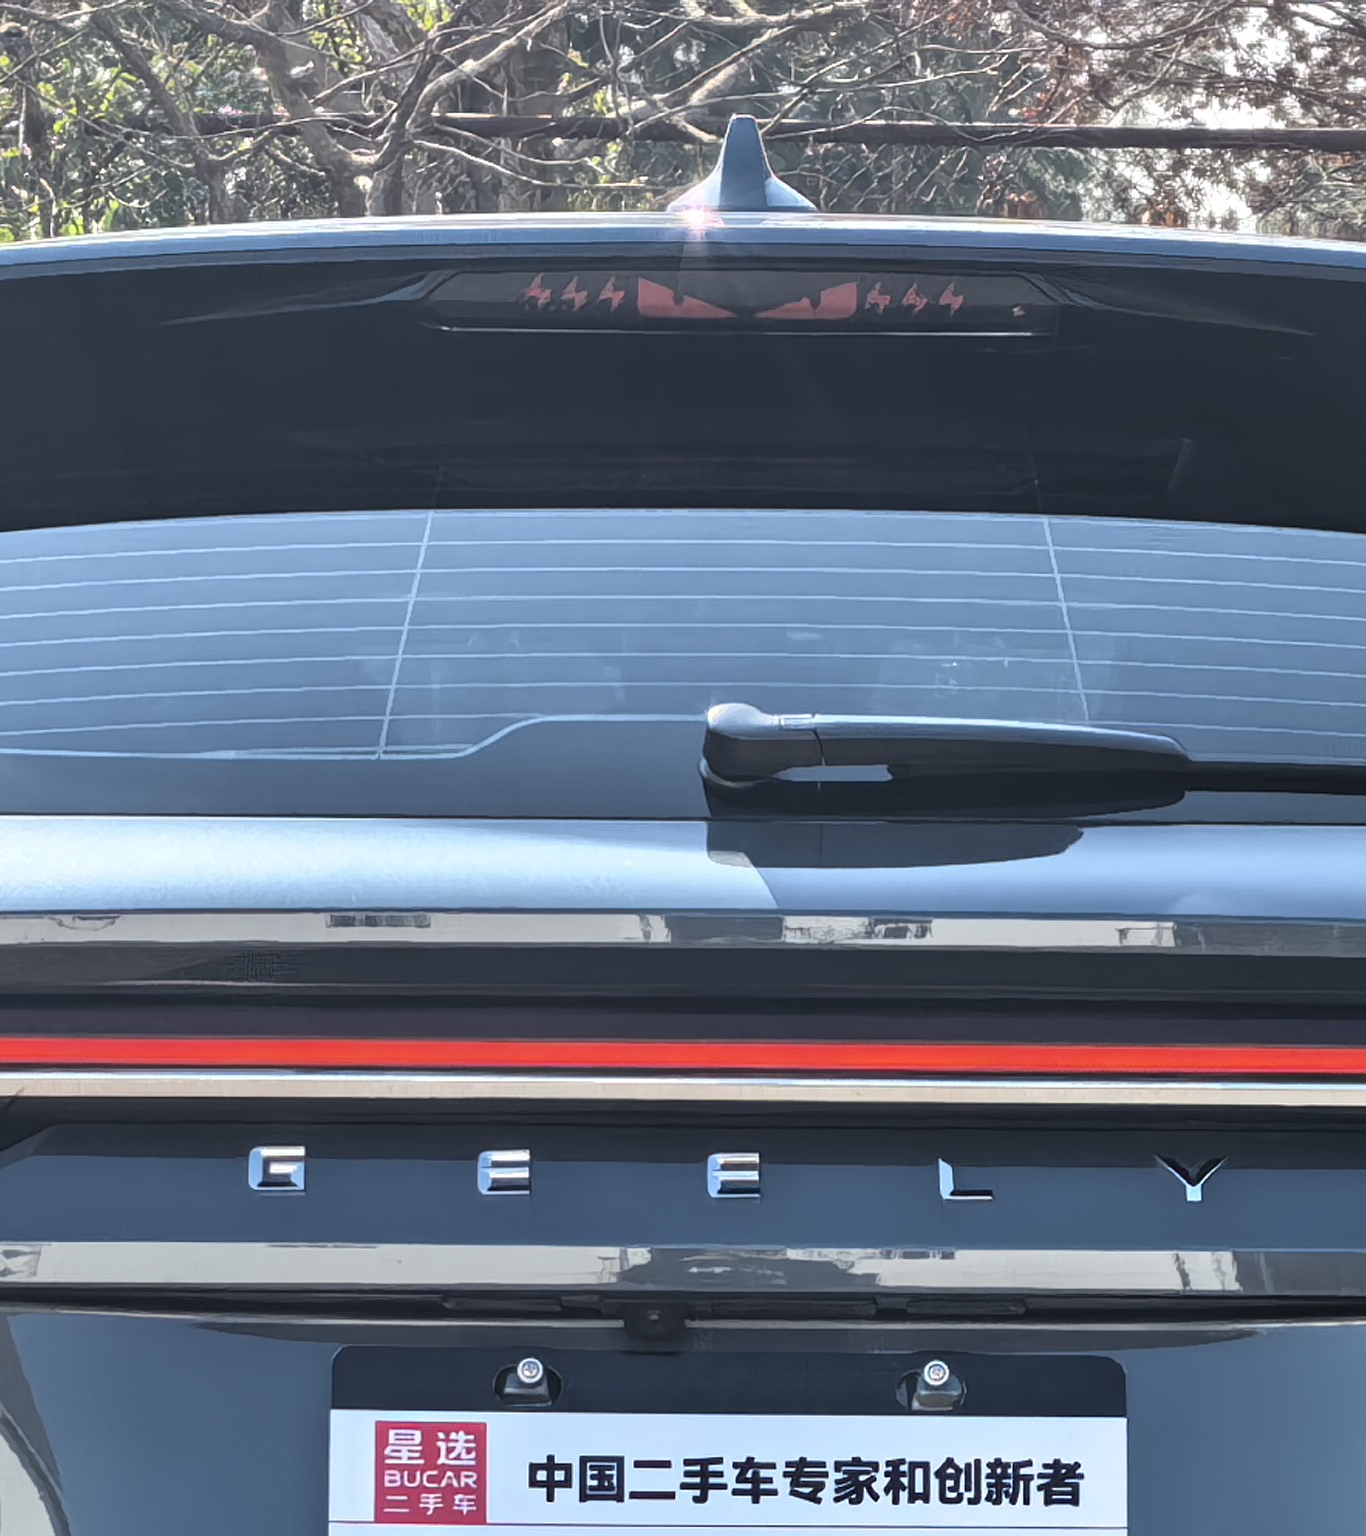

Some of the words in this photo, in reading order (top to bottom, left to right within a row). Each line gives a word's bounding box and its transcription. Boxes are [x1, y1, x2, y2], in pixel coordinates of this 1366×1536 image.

[247, 1145, 1228, 1202] GEELY
[384, 1429, 476, 1465] 星选
[384, 1470, 477, 1488] BUCAR
[528, 1454, 1085, 1507] 中国二手车专家和创新者
[383, 1493, 477, 1515] 二手车
